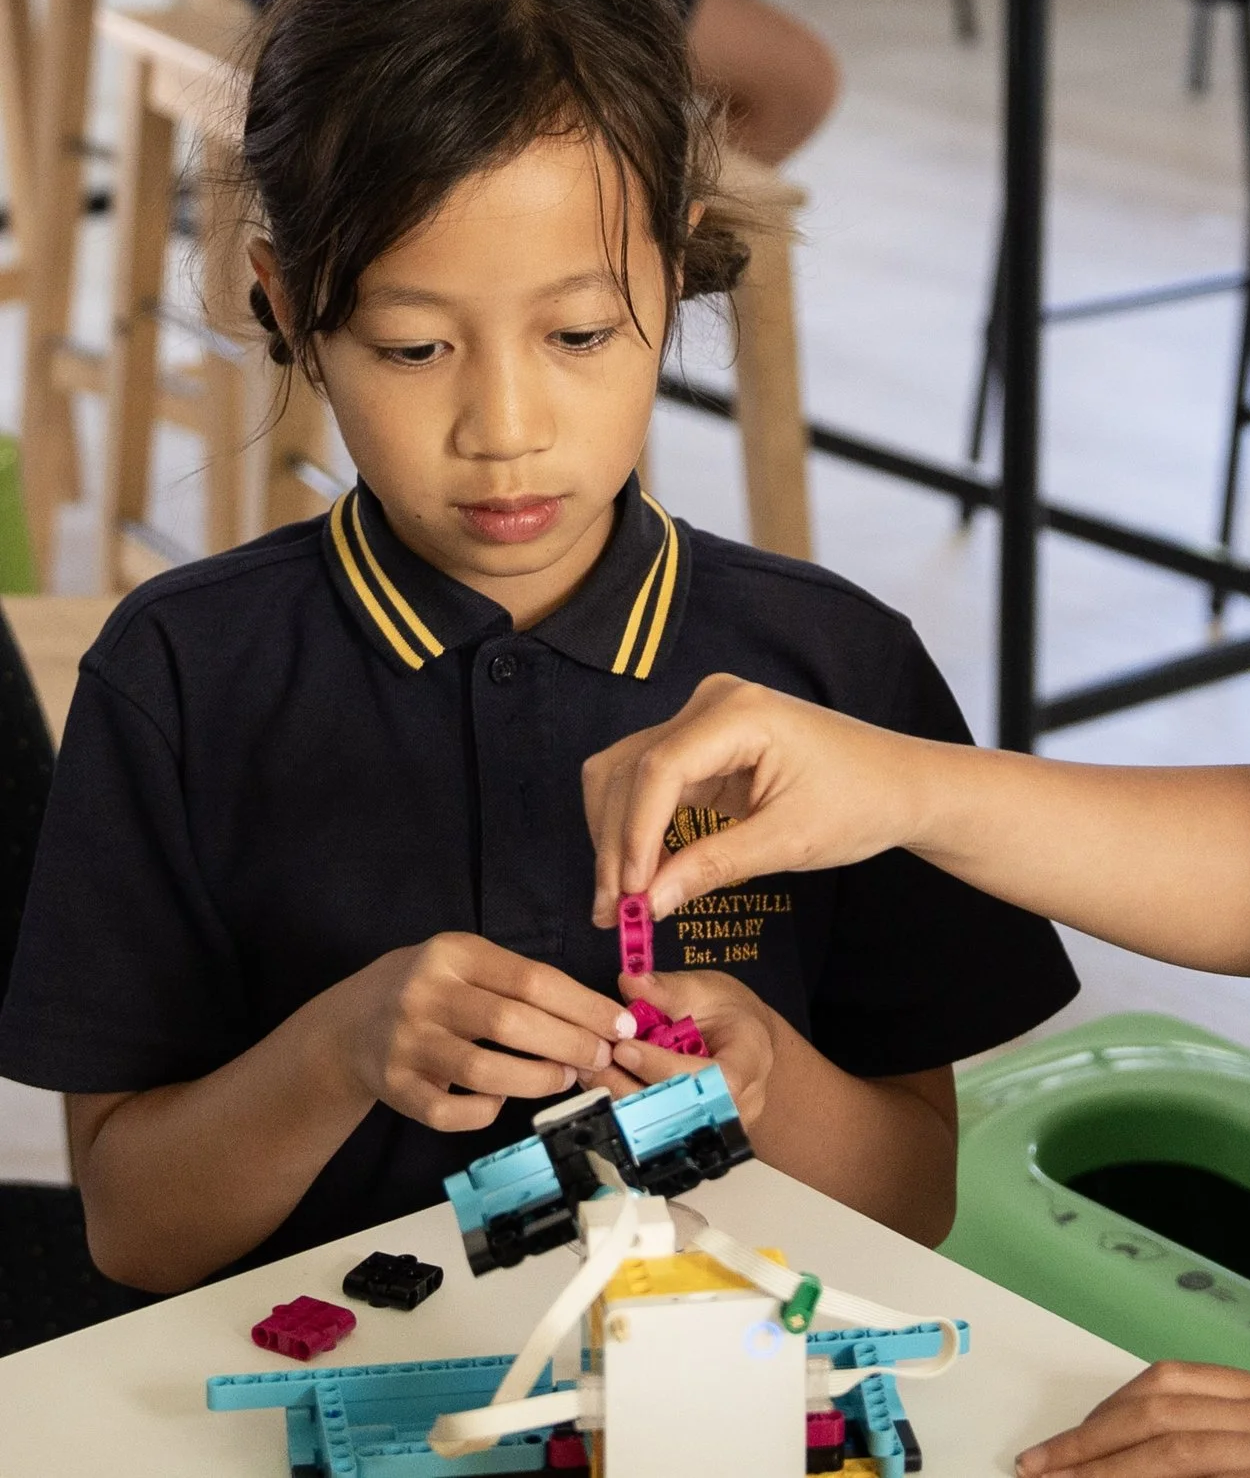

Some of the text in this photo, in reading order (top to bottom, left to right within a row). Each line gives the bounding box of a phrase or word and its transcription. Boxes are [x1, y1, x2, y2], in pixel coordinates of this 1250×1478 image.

[676, 918, 764, 940] PRIMARY
[683, 942, 758, 964] Est. 1884
